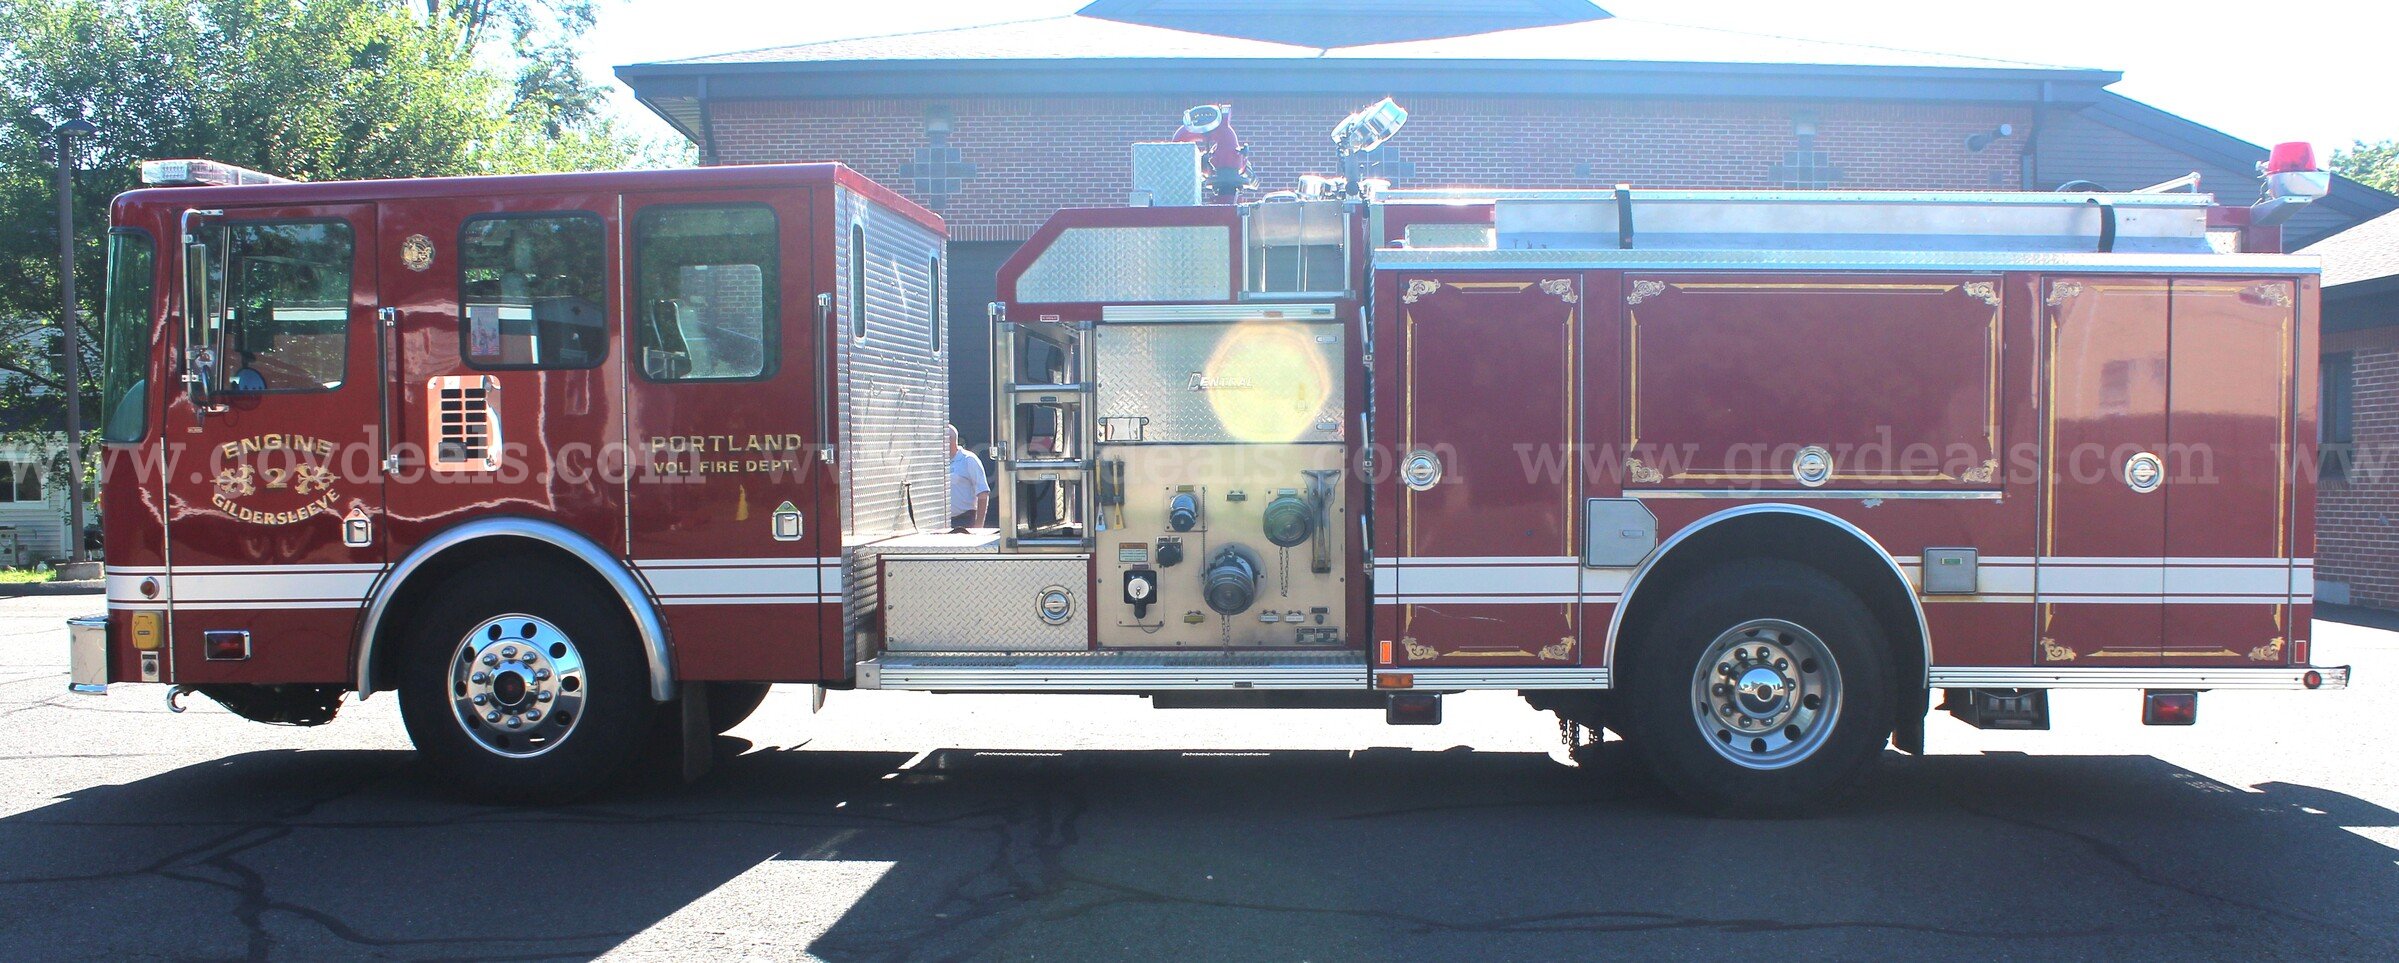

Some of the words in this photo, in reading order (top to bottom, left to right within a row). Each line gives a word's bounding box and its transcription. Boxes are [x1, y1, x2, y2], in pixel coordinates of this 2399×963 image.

[222, 433, 333, 459] ENGINE
[651, 434, 802, 453] PORTLAND
[655, 461, 693, 474] VOL.
[700, 460, 739, 473] FIRE
[745, 459, 797, 472] DEPT.
[265, 467, 288, 489] 2
[212, 488, 341, 525] GILDERSLEEVE
